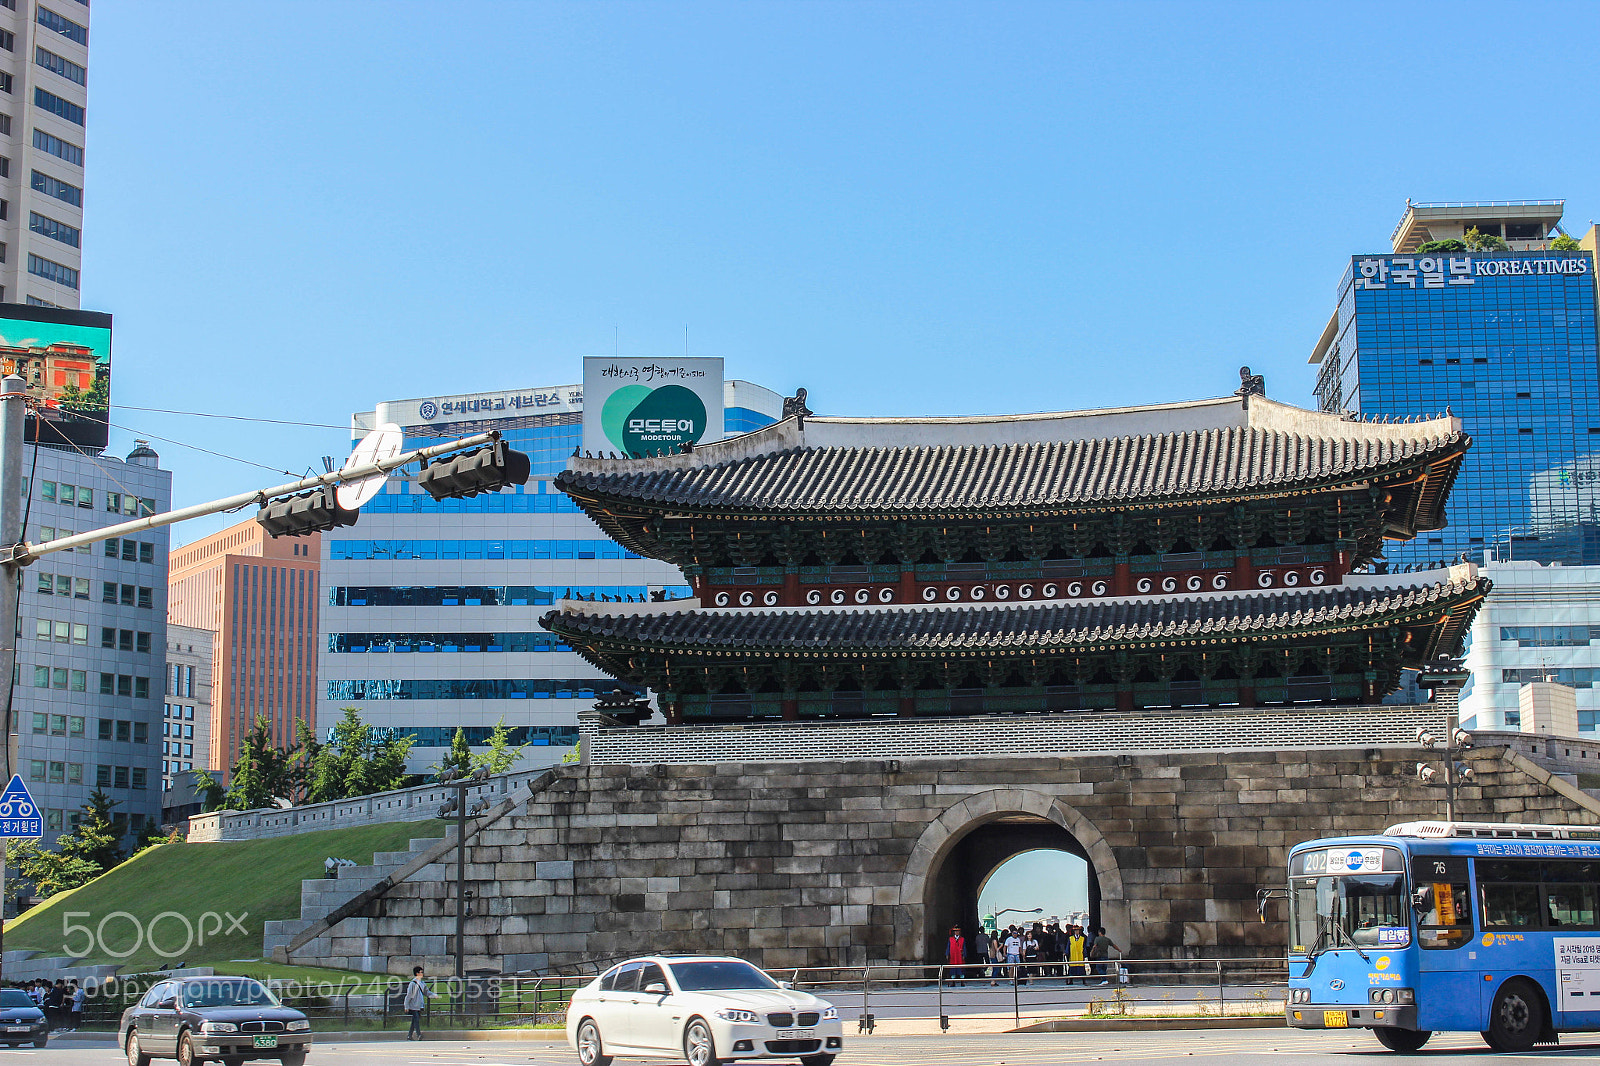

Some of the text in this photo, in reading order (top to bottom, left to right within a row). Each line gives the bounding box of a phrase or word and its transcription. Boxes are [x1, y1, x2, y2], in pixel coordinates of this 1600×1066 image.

[1359, 257, 1475, 290] 한국일보
[441, 393, 561, 415] 연세대학교 세브란스
[629, 419, 694, 434] 모두투어
[0, 821, 38, 833] 전거횡단
[1503, 845, 1522, 855] 당신이
[1306, 854, 1327, 871] 202
[1433, 861, 1446, 874] 76
[254, 1039, 277, 1047] 6380
